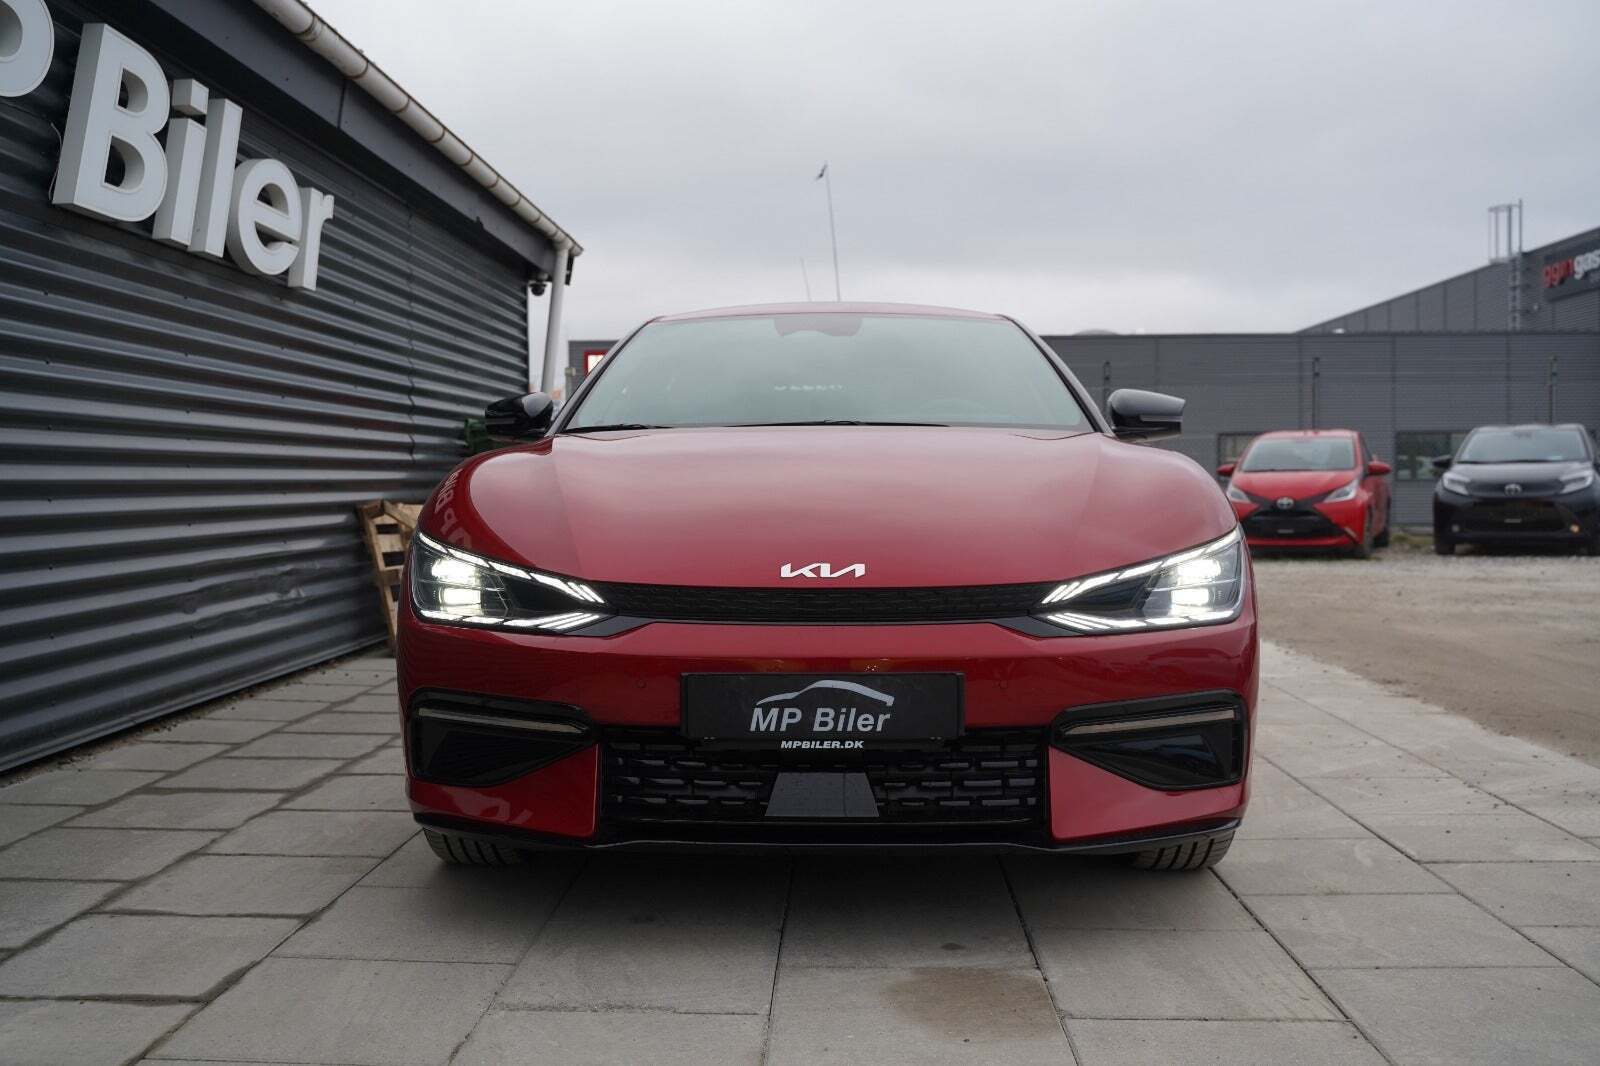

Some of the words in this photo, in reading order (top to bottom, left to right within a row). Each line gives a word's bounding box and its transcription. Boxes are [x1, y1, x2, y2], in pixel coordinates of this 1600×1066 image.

[52, 22, 335, 291] Biler
[750, 707, 802, 732] MP
[813, 707, 891, 732] Biler
[780, 740, 865, 750] MPBILER.DK
